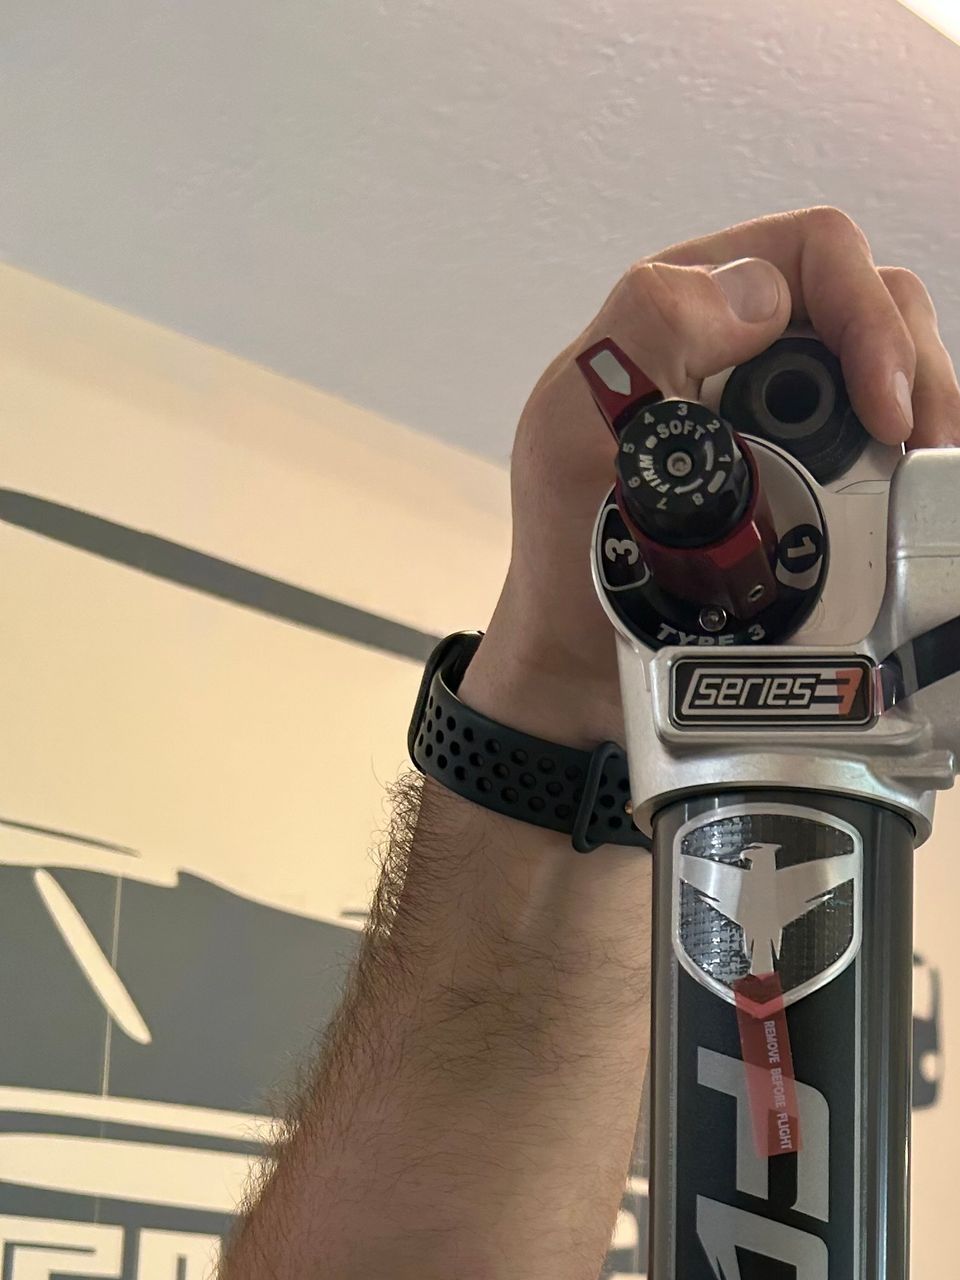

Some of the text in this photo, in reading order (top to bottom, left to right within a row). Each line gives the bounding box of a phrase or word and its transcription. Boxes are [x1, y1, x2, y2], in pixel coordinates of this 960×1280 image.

[677, 403, 688, 416] 3
[656, 419, 706, 440] SOFT
[639, 454, 671, 493] FIRM
[604, 538, 640, 567] 3
[786, 535, 816, 560] 1
[656, 622, 766, 646] TYPE 3
[763, 1020, 792, 1149] REMOVE BEFORE FLIGHT
